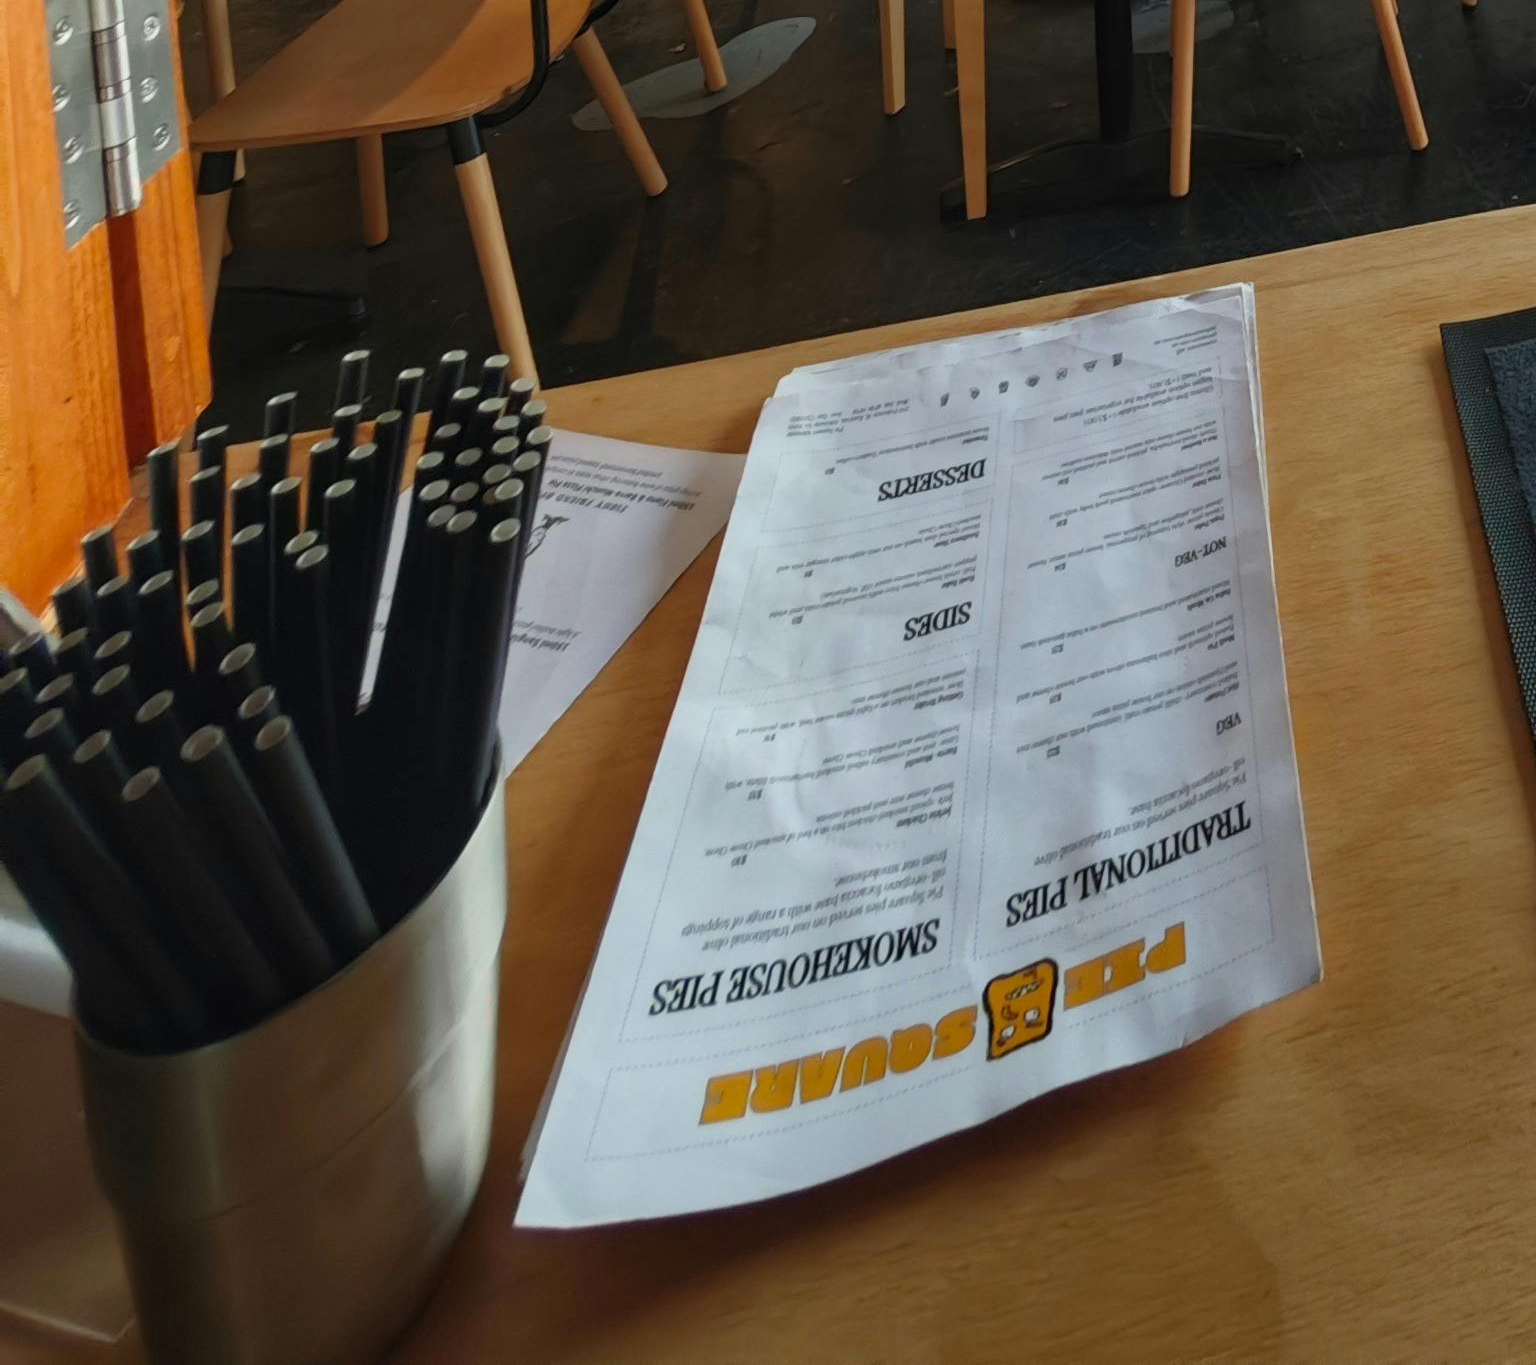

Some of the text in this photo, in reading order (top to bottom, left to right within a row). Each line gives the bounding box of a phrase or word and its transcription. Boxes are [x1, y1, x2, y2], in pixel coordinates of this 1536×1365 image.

[877, 458, 987, 502] DESSERTS
[1174, 536, 1227, 567] NOT-VEG
[903, 601, 972, 642] SIDES
[1215, 712, 1242, 736] VEG
[1005, 800, 1251, 928] TRADITIONAL PIES
[828, 907, 864, 926] served
[888, 890, 925, 910] Square
[730, 924, 790, 949] traditional
[648, 918, 940, 1016] SMOKEHOUSE PIES
[697, 921, 1186, 1126] PIE SQUARE
